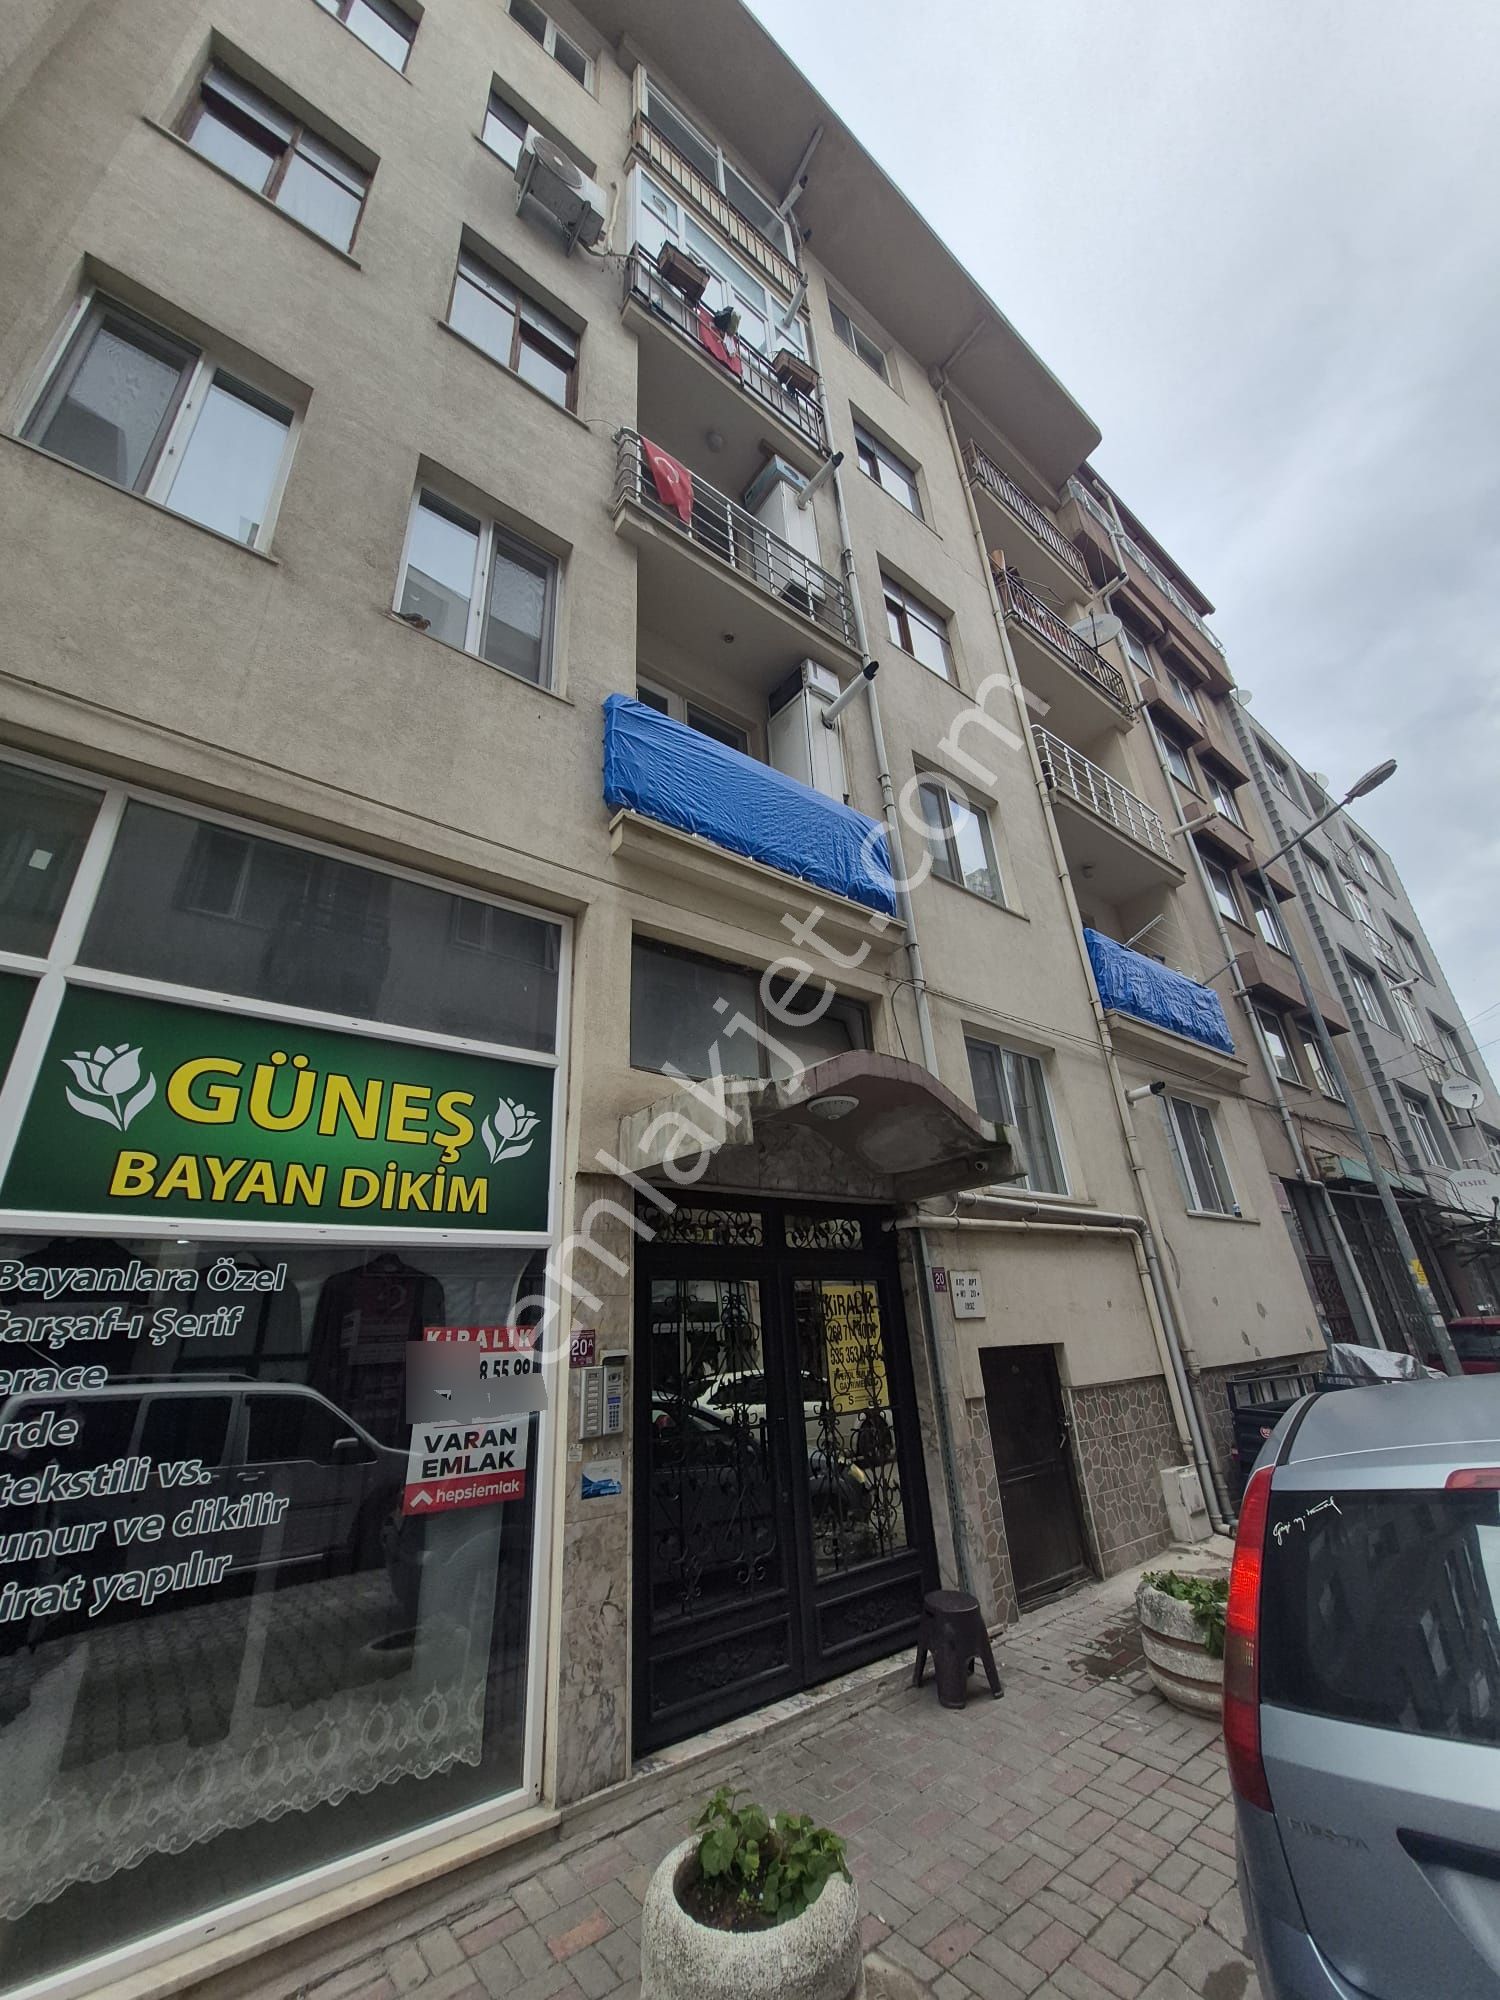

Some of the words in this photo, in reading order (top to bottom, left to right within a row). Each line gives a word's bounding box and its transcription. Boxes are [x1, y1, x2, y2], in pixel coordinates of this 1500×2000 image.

[165, 1050, 476, 1164] GÜNEŞ
[108, 1150, 327, 1207] BAYAN
[338, 1160, 489, 1215] DİKİM
[0, 1259, 199, 1299] Bayanlara
[207, 1257, 287, 1292] Özel
[935, 1273, 945, 1285] 20
[150, 1305, 244, 1345] Şerif
[0, 1411, 78, 1450] rde
[424, 1427, 518, 1453] VARAN
[0, 1456, 151, 1508] tekstili
[158, 1459, 212, 1489] vs.
[421, 1450, 515, 1479] EMLAK
[436, 1479, 520, 1503] hepsiemlak
[114, 1514, 165, 1546] ve
[172, 1491, 289, 1538] dikilir
[89, 1550, 233, 1618] yapılır
